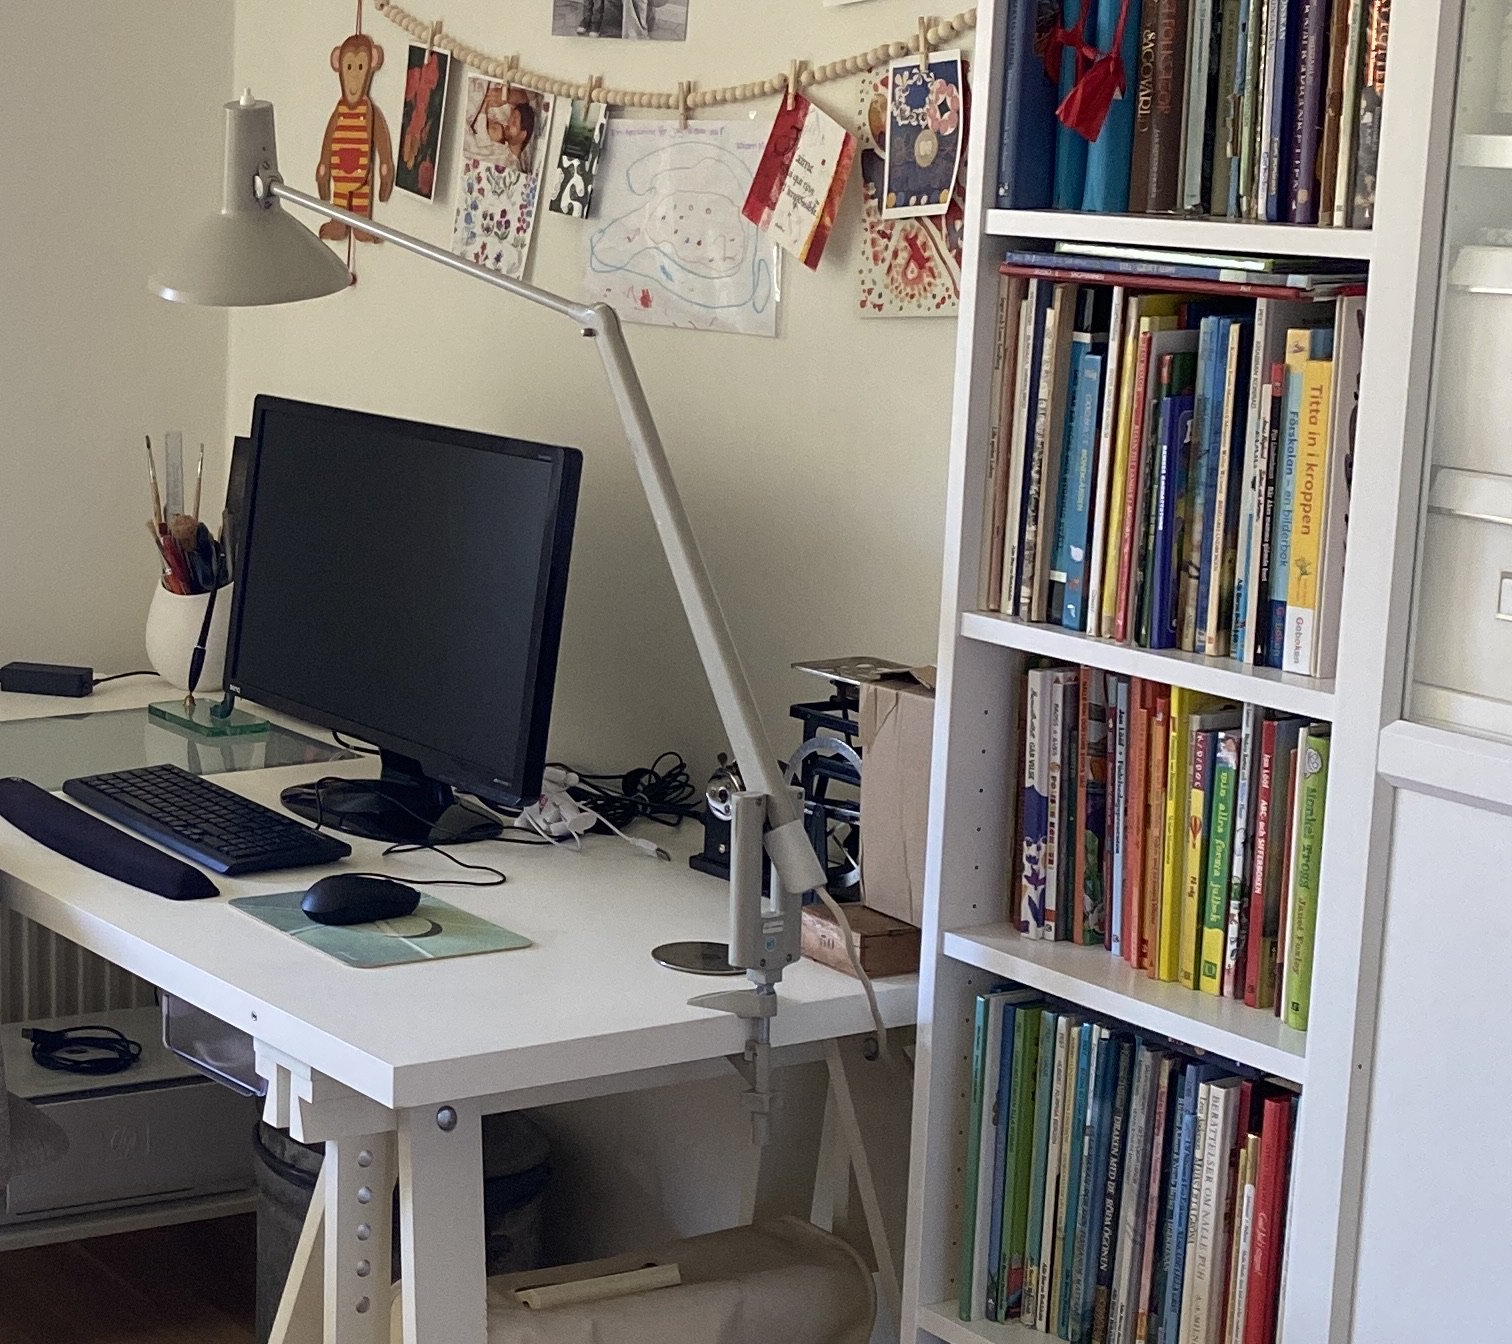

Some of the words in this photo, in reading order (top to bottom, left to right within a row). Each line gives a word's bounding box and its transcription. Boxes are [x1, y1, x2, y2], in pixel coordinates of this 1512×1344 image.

[1306, 383, 1324, 426] Titta
[1284, 410, 1298, 476] Förskolan
[1306, 430, 1319, 447] in
[1283, 490, 1291, 506] en
[1295, 462, 1318, 536] kroppen
[1278, 508, 1292, 567] bilderbok
[1262, 754, 1271, 769] Jan
[1218, 772, 1228, 796] min
[1216, 803, 1228, 833] allra
[1258, 821, 1266, 836] och
[1253, 837, 1265, 894] SIFFERBOKEN
[1298, 844, 1313, 889] Trogg
[1206, 881, 1223, 922] julbok
[1296, 897, 1306, 931] Janet
[1109, 1115, 1122, 1155] DRAKEN
[1205, 1094, 1221, 1183] BERÄTTELSER
[1107, 1156, 1118, 1180] MED
[1103, 1198, 1115, 1226] RÖDA
[1203, 1187, 1212, 1206] OM
[1098, 1226, 1112, 1271] ÖGONEN
[1199, 1210, 1211, 1252] NALLE
[1196, 1255, 1206, 1280] PUH
